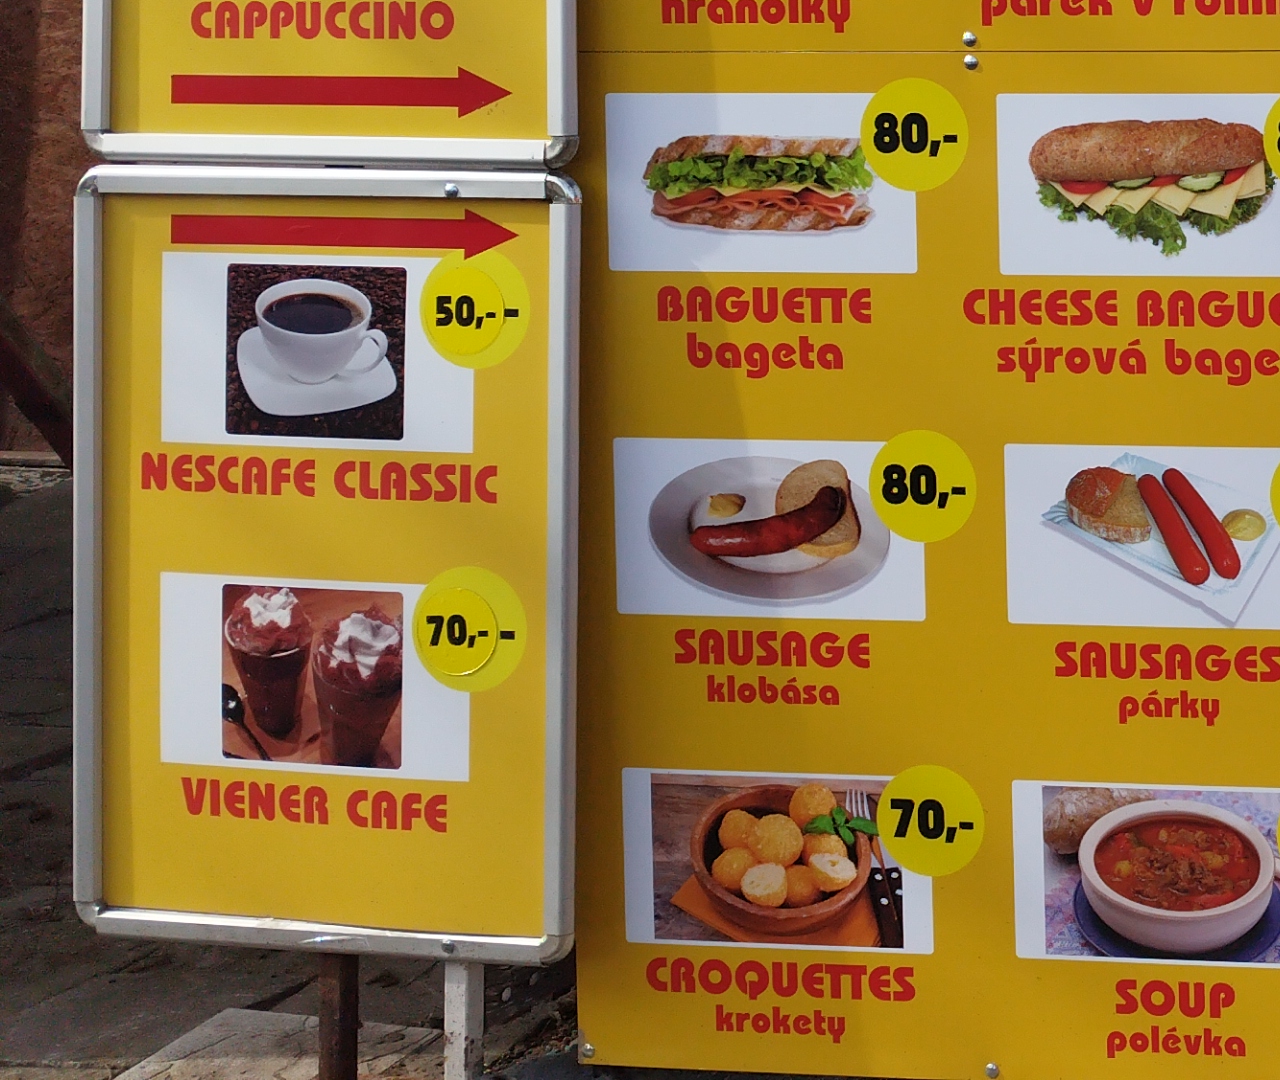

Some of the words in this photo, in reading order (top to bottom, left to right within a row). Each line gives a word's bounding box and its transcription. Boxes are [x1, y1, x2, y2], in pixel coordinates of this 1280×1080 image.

[190, 0, 455, 40] CAPPUCCINO
[873, 112, 958, 157] 80,-
[657, 285, 873, 323] BAGUETTE
[963, 289, 1119, 326] CHEESE
[686, 337, 844, 379] bageta
[997, 338, 1148, 384] sýrová
[140, 452, 315, 498] NESCAFE
[333, 461, 498, 504] CLASSIC
[881, 464, 967, 510] 80,-
[674, 629, 871, 670] SAUSAGE
[706, 675, 840, 707] klobása
[1118, 689, 1220, 726] párky
[182, 776, 329, 825] VIENER
[346, 789, 448, 833] CAFE
[890, 798, 974, 844] 70,-
[645, 956, 916, 1002] CROQUETTES
[1115, 979, 1236, 1020] SOUP
[715, 1004, 847, 1044] krokety
[1106, 1027, 1246, 1062] polévka
